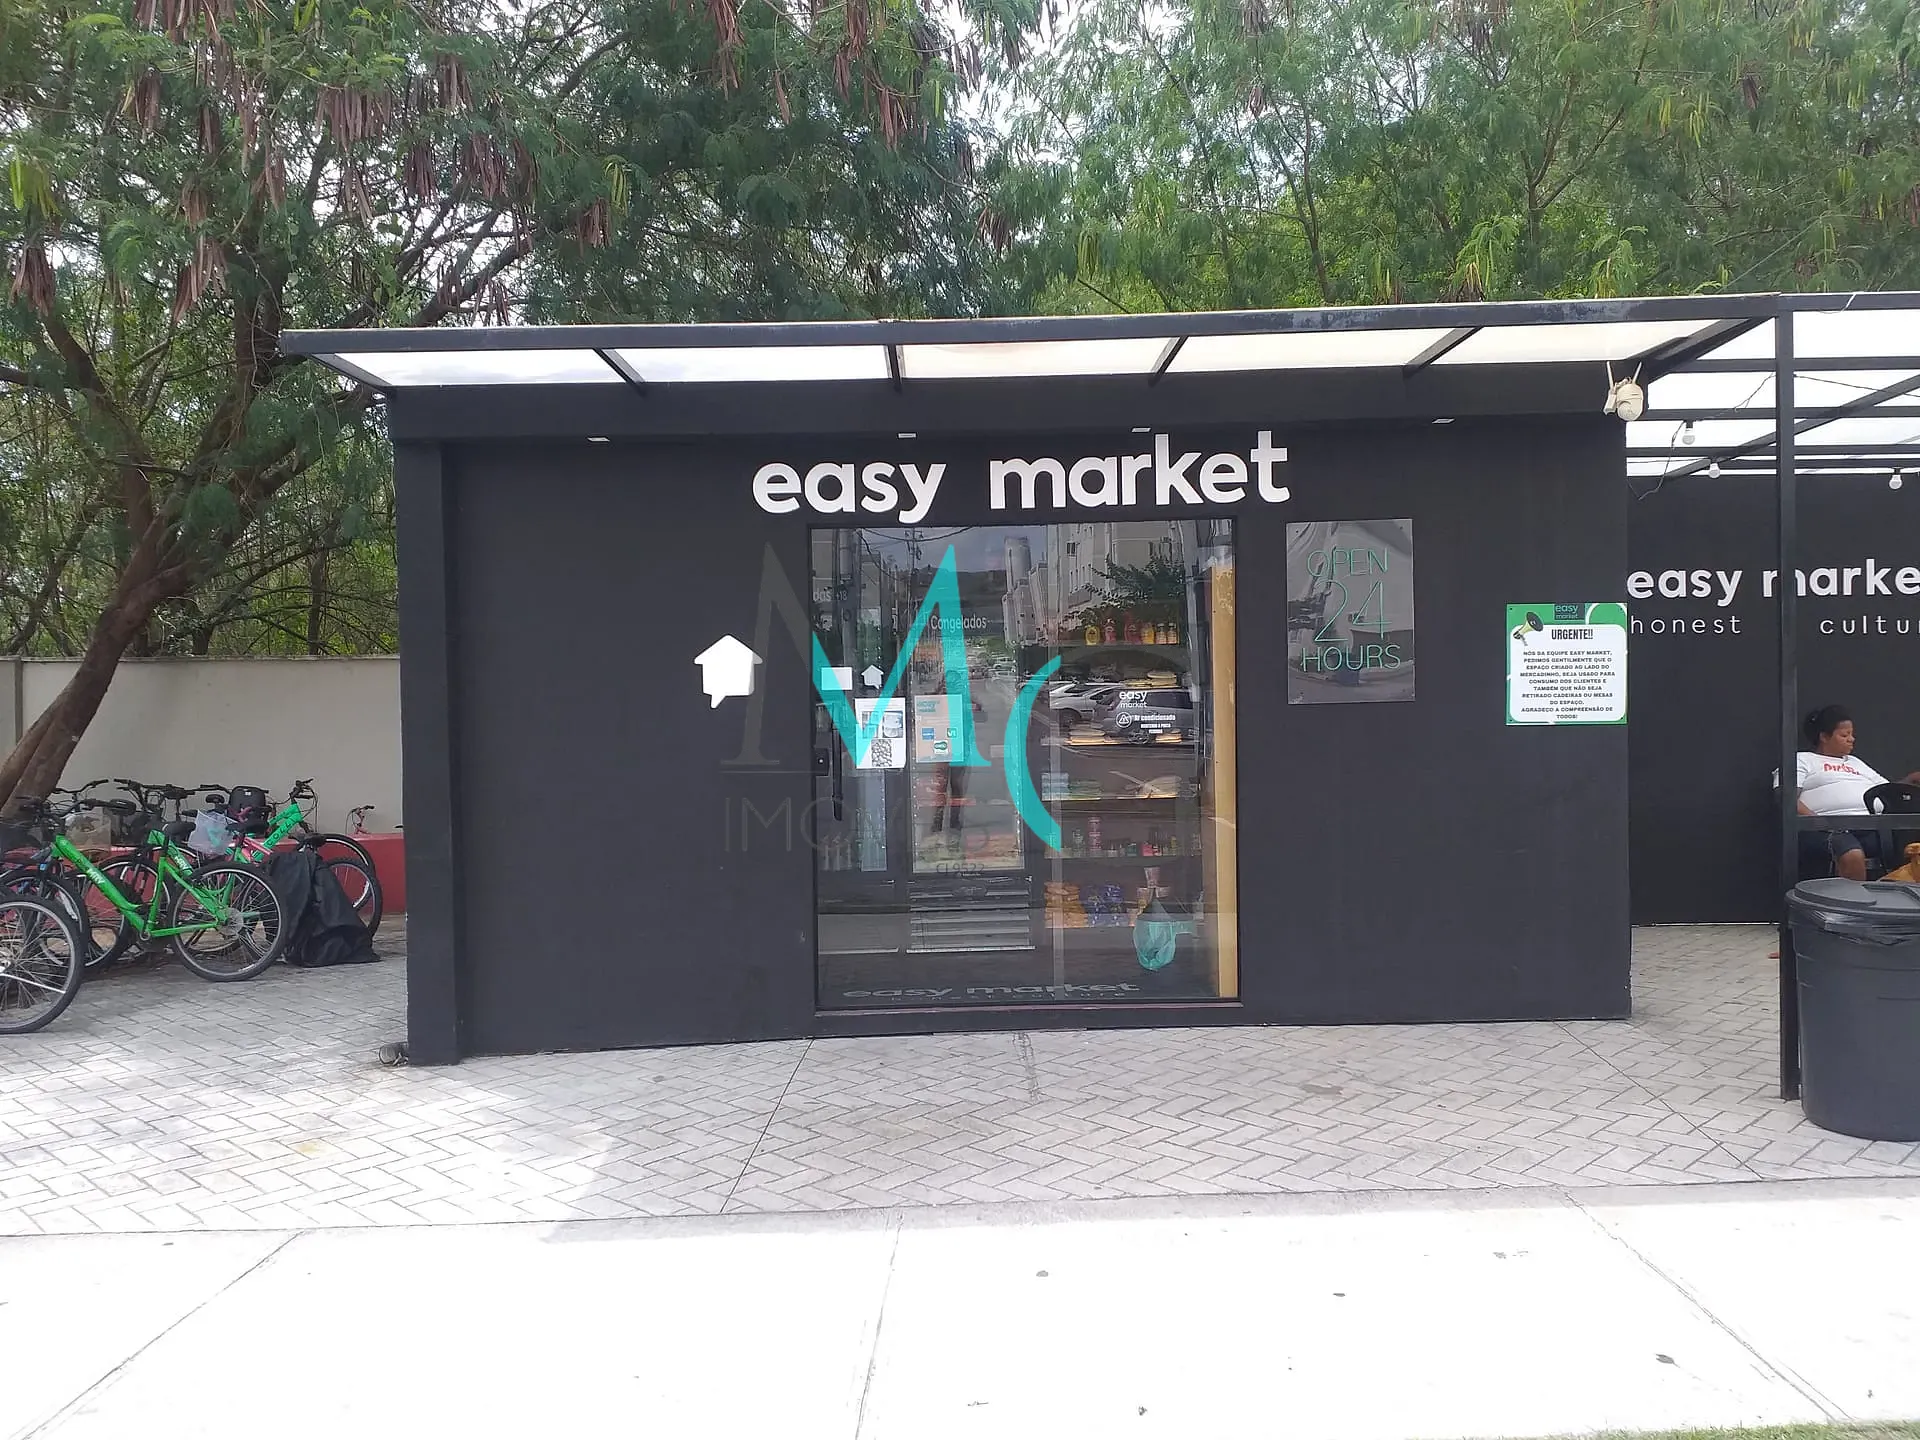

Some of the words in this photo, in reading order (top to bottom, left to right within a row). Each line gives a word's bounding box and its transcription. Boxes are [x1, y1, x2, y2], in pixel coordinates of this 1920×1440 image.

[753, 462, 947, 524] easy
[989, 430, 1290, 510] market
[1307, 548, 1389, 577] OPEN
[1626, 569, 1743, 607] easy
[1314, 579, 1392, 642] 24
[1555, 604, 1579, 613] easy
[930, 615, 987, 633] Congelados
[1631, 615, 1741, 634] honest
[1819, 615, 1920, 634] cultu
[1551, 629, 1594, 640] URGENTE!!
[1302, 644, 1401, 672] HOURS
[1119, 691, 1148, 702] easy
[966, 982, 1140, 995] market
